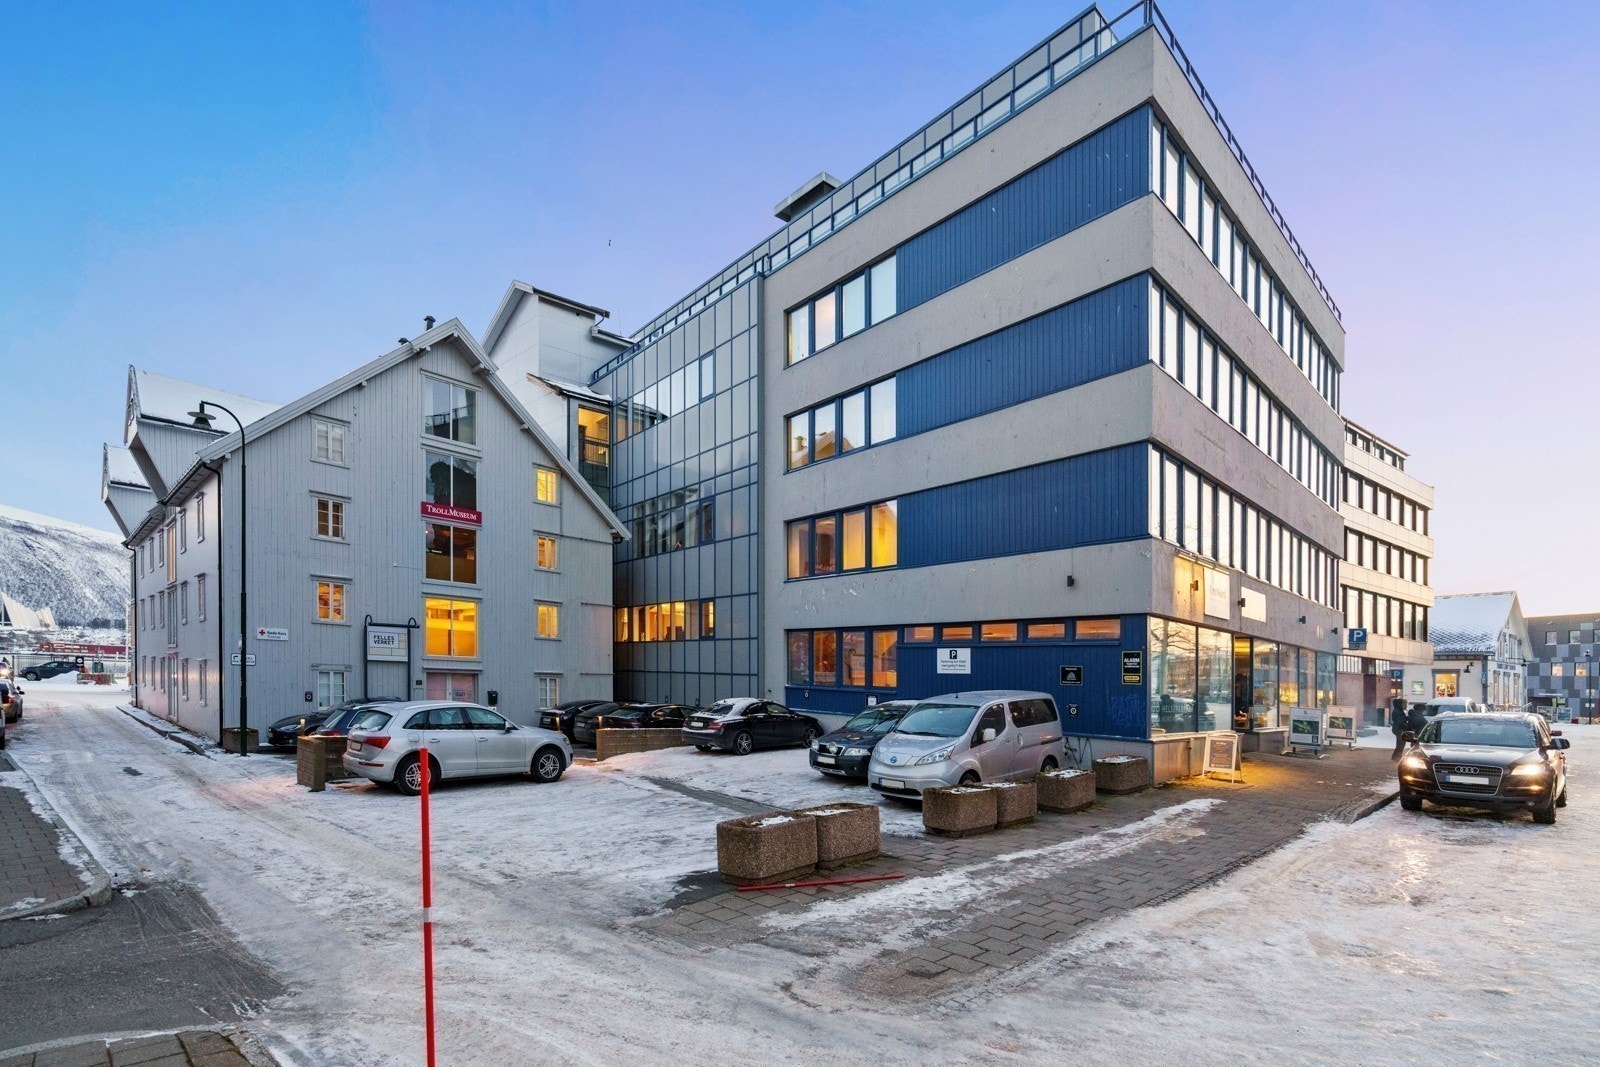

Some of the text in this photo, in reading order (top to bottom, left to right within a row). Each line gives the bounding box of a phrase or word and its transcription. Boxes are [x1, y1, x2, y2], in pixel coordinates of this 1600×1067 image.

[1353, 630, 1364, 642] P
[951, 650, 957, 659] P
[1393, 671, 1401, 679] P
